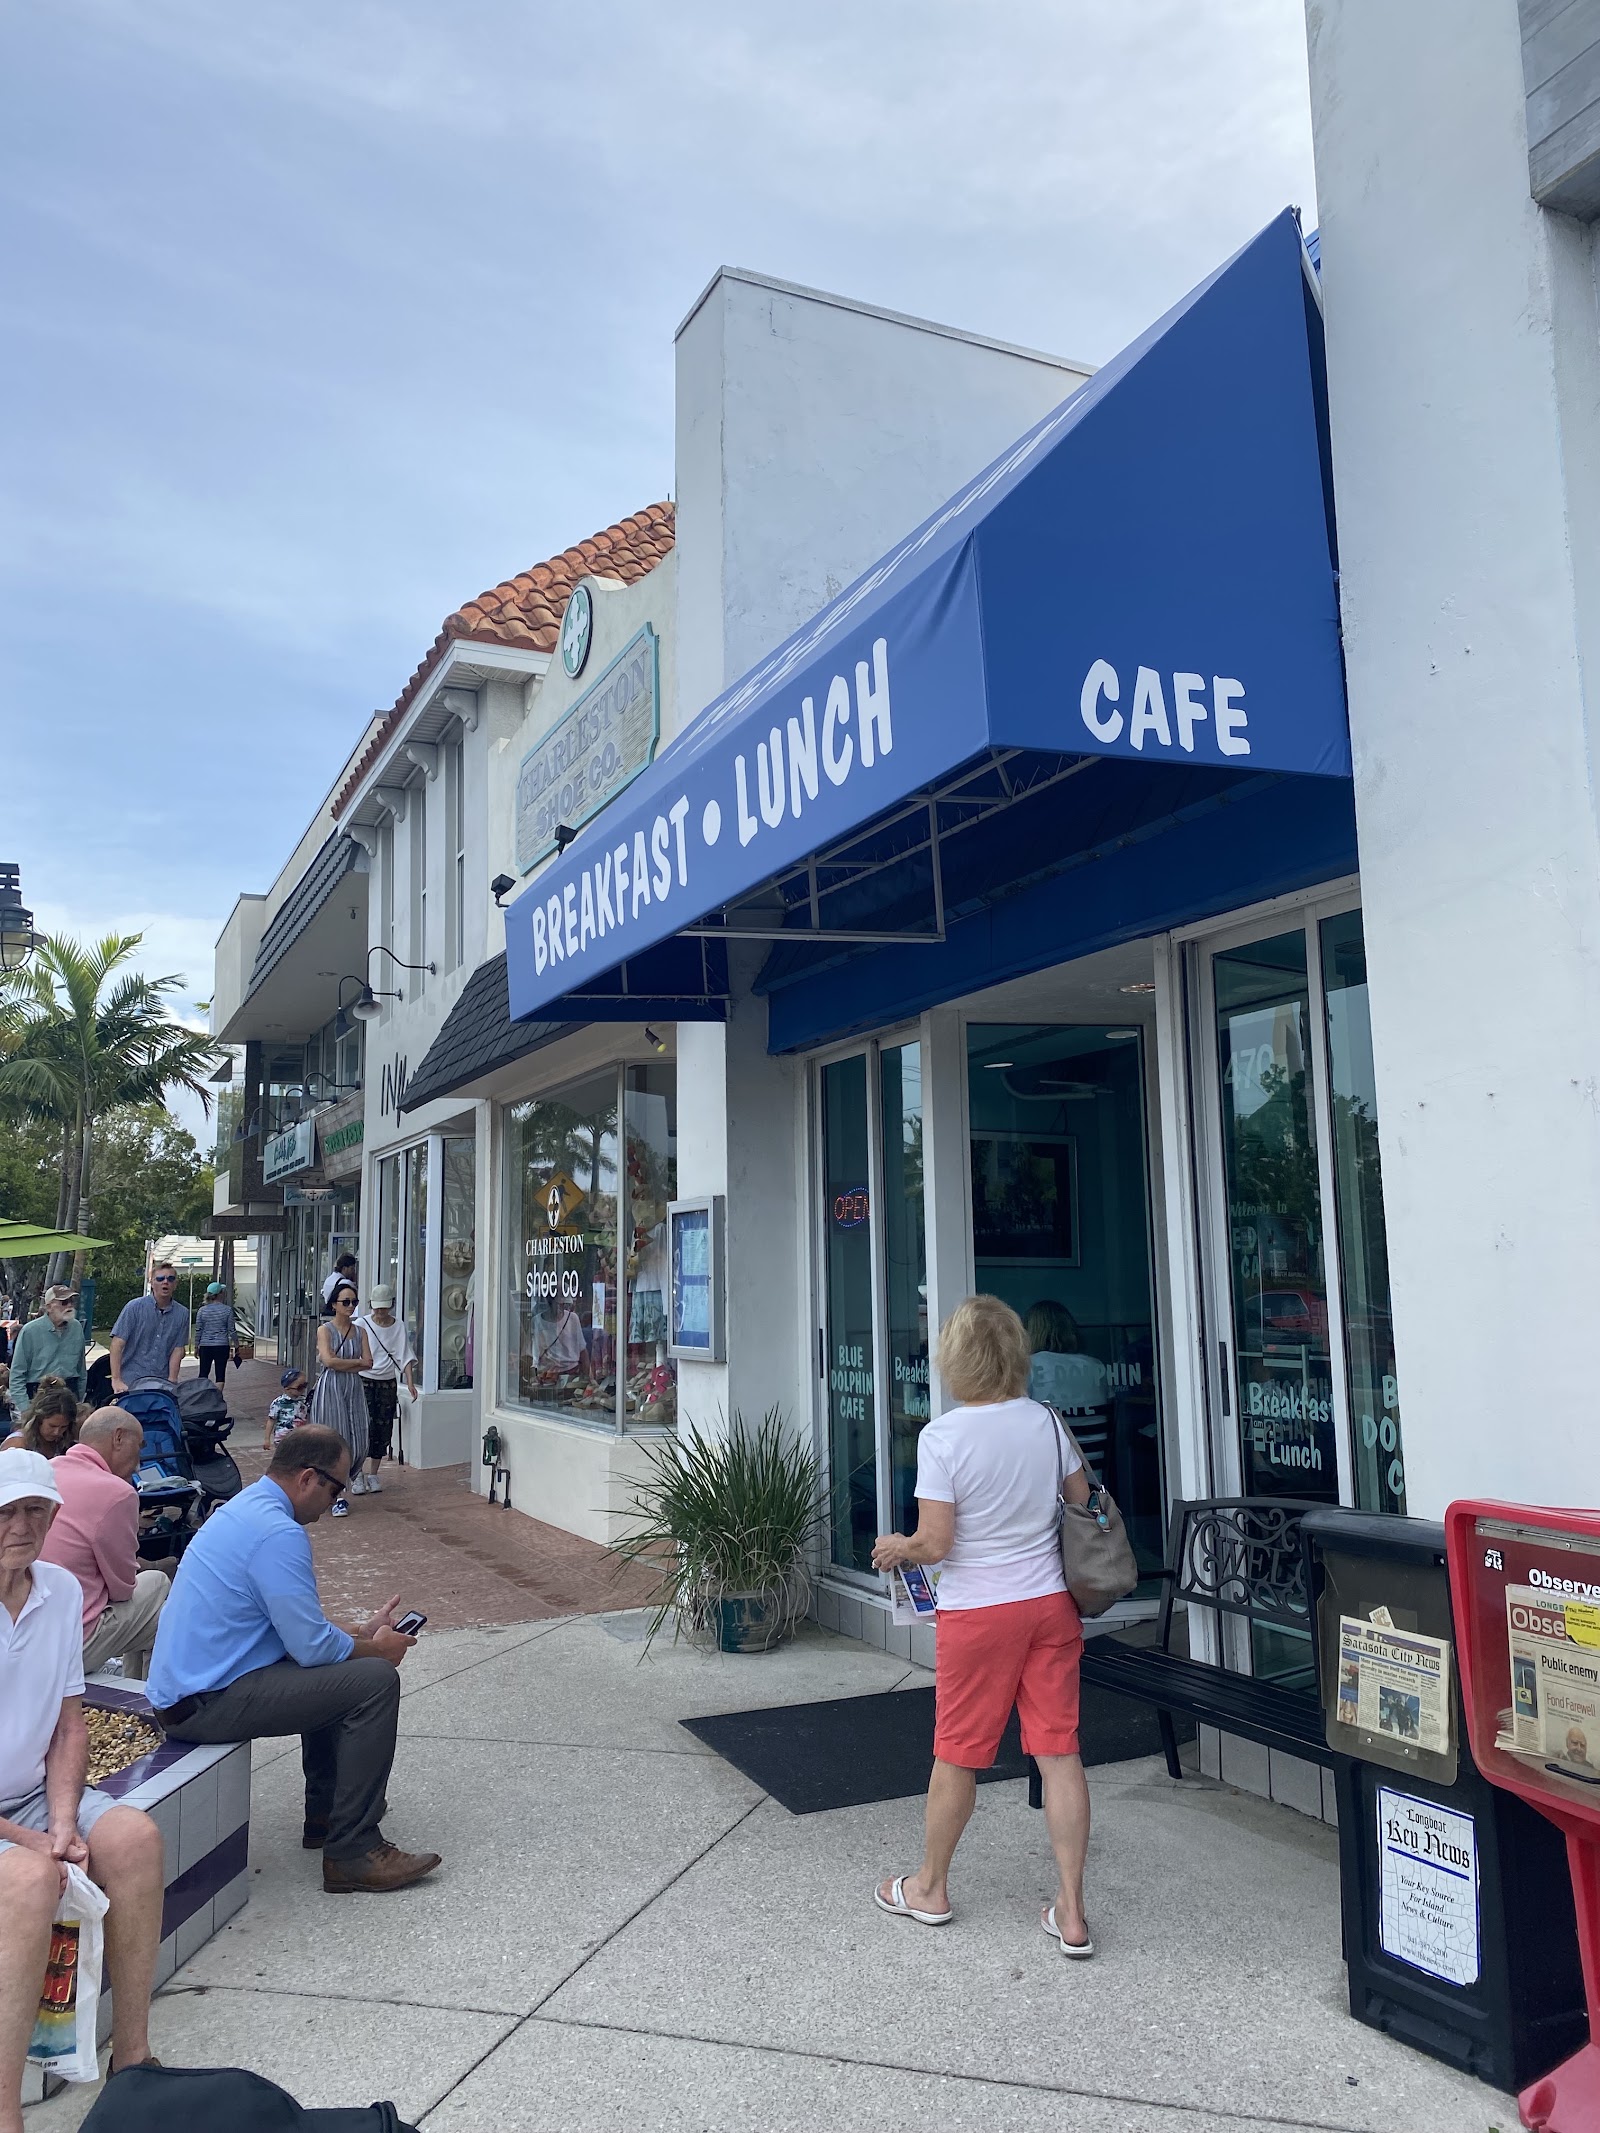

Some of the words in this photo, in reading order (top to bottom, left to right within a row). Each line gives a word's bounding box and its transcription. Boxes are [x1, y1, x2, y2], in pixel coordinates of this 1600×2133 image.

[1080, 658, 1251, 756] CAFE
[520, 650, 648, 811] CHARLESTON
[536, 771, 584, 839] SHOE
[588, 742, 621, 791] CO.
[532, 795, 690, 976] BREAKFAST
[735, 638, 892, 847] LUNCH
[1224, 1044, 1274, 1092] 470
[834, 1195, 870, 1220] OPEN
[525, 1234, 584, 1257] CHARLESTON
[526, 1263, 557, 1298] shoe
[562, 1269, 583, 1298] co.
[838, 1345, 863, 1369] BLUE
[831, 1369, 873, 1396] DOLPHIN
[840, 1395, 865, 1421] CAFE
[1249, 1381, 1335, 1423] Breakfast
[1270, 1434, 1322, 1471] Lunch
[1512, 1607, 1565, 1637] Obse
[1342, 1634, 1388, 1657] Sarasota
[1391, 1648, 1413, 1666] City
[1415, 1653, 1440, 1670] News
[1541, 1655, 1567, 1673] Public
[1568, 1663, 1598, 1682] enemy
[1546, 1693, 1565, 1709] Fond
[1565, 1697, 1596, 1717] Farewell
[1406, 1808, 1447, 1834] Longboat
[1386, 1819, 1419, 1854] Key
[1424, 1831, 1470, 1868] News
[1400, 1875, 1415, 1889] Your
[1416, 1880, 1430, 1895] Key
[1430, 1887, 1455, 1903] Source
[1409, 1893, 1421, 1905] For
[1422, 1897, 1444, 1914] Island
[1401, 1901, 1418, 1916] News
[1419, 1910, 1426, 1919] &
[1427, 1912, 1454, 1930] Culture
